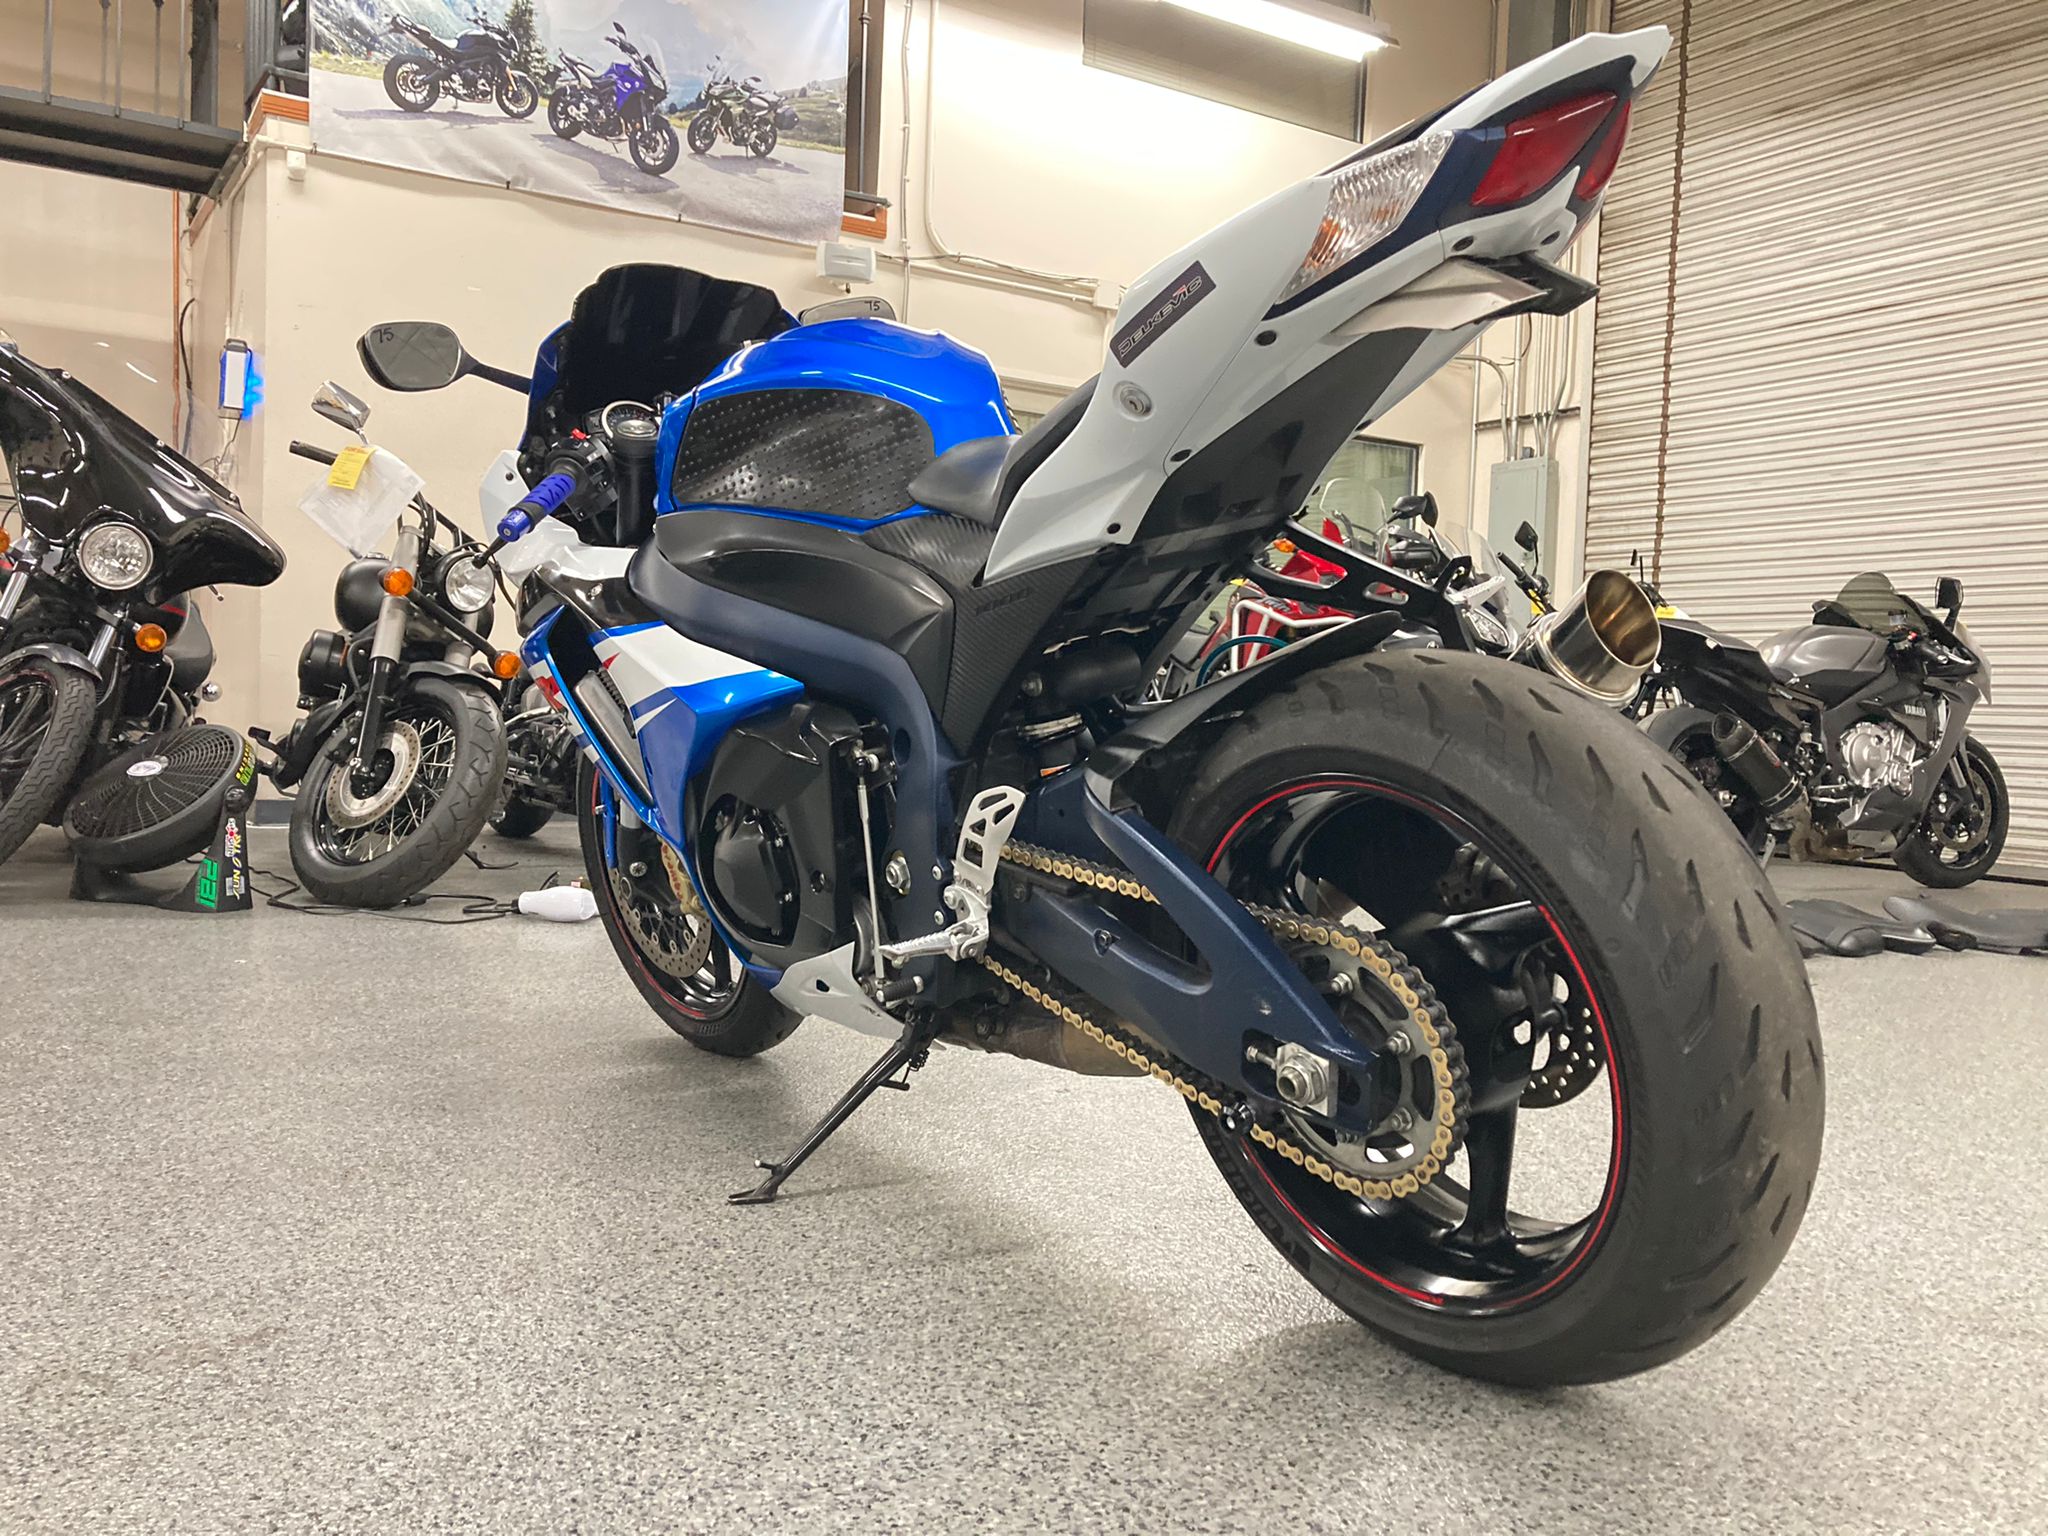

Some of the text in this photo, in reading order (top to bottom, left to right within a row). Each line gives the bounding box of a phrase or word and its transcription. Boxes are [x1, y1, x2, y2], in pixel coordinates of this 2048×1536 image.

[1117, 275, 1203, 358] DELKEVIC
[1903, 704, 1927, 718] YAMAHA
[199, 857, 219, 909] PBI
[1200, 1119, 1279, 1232] MICHELIN
